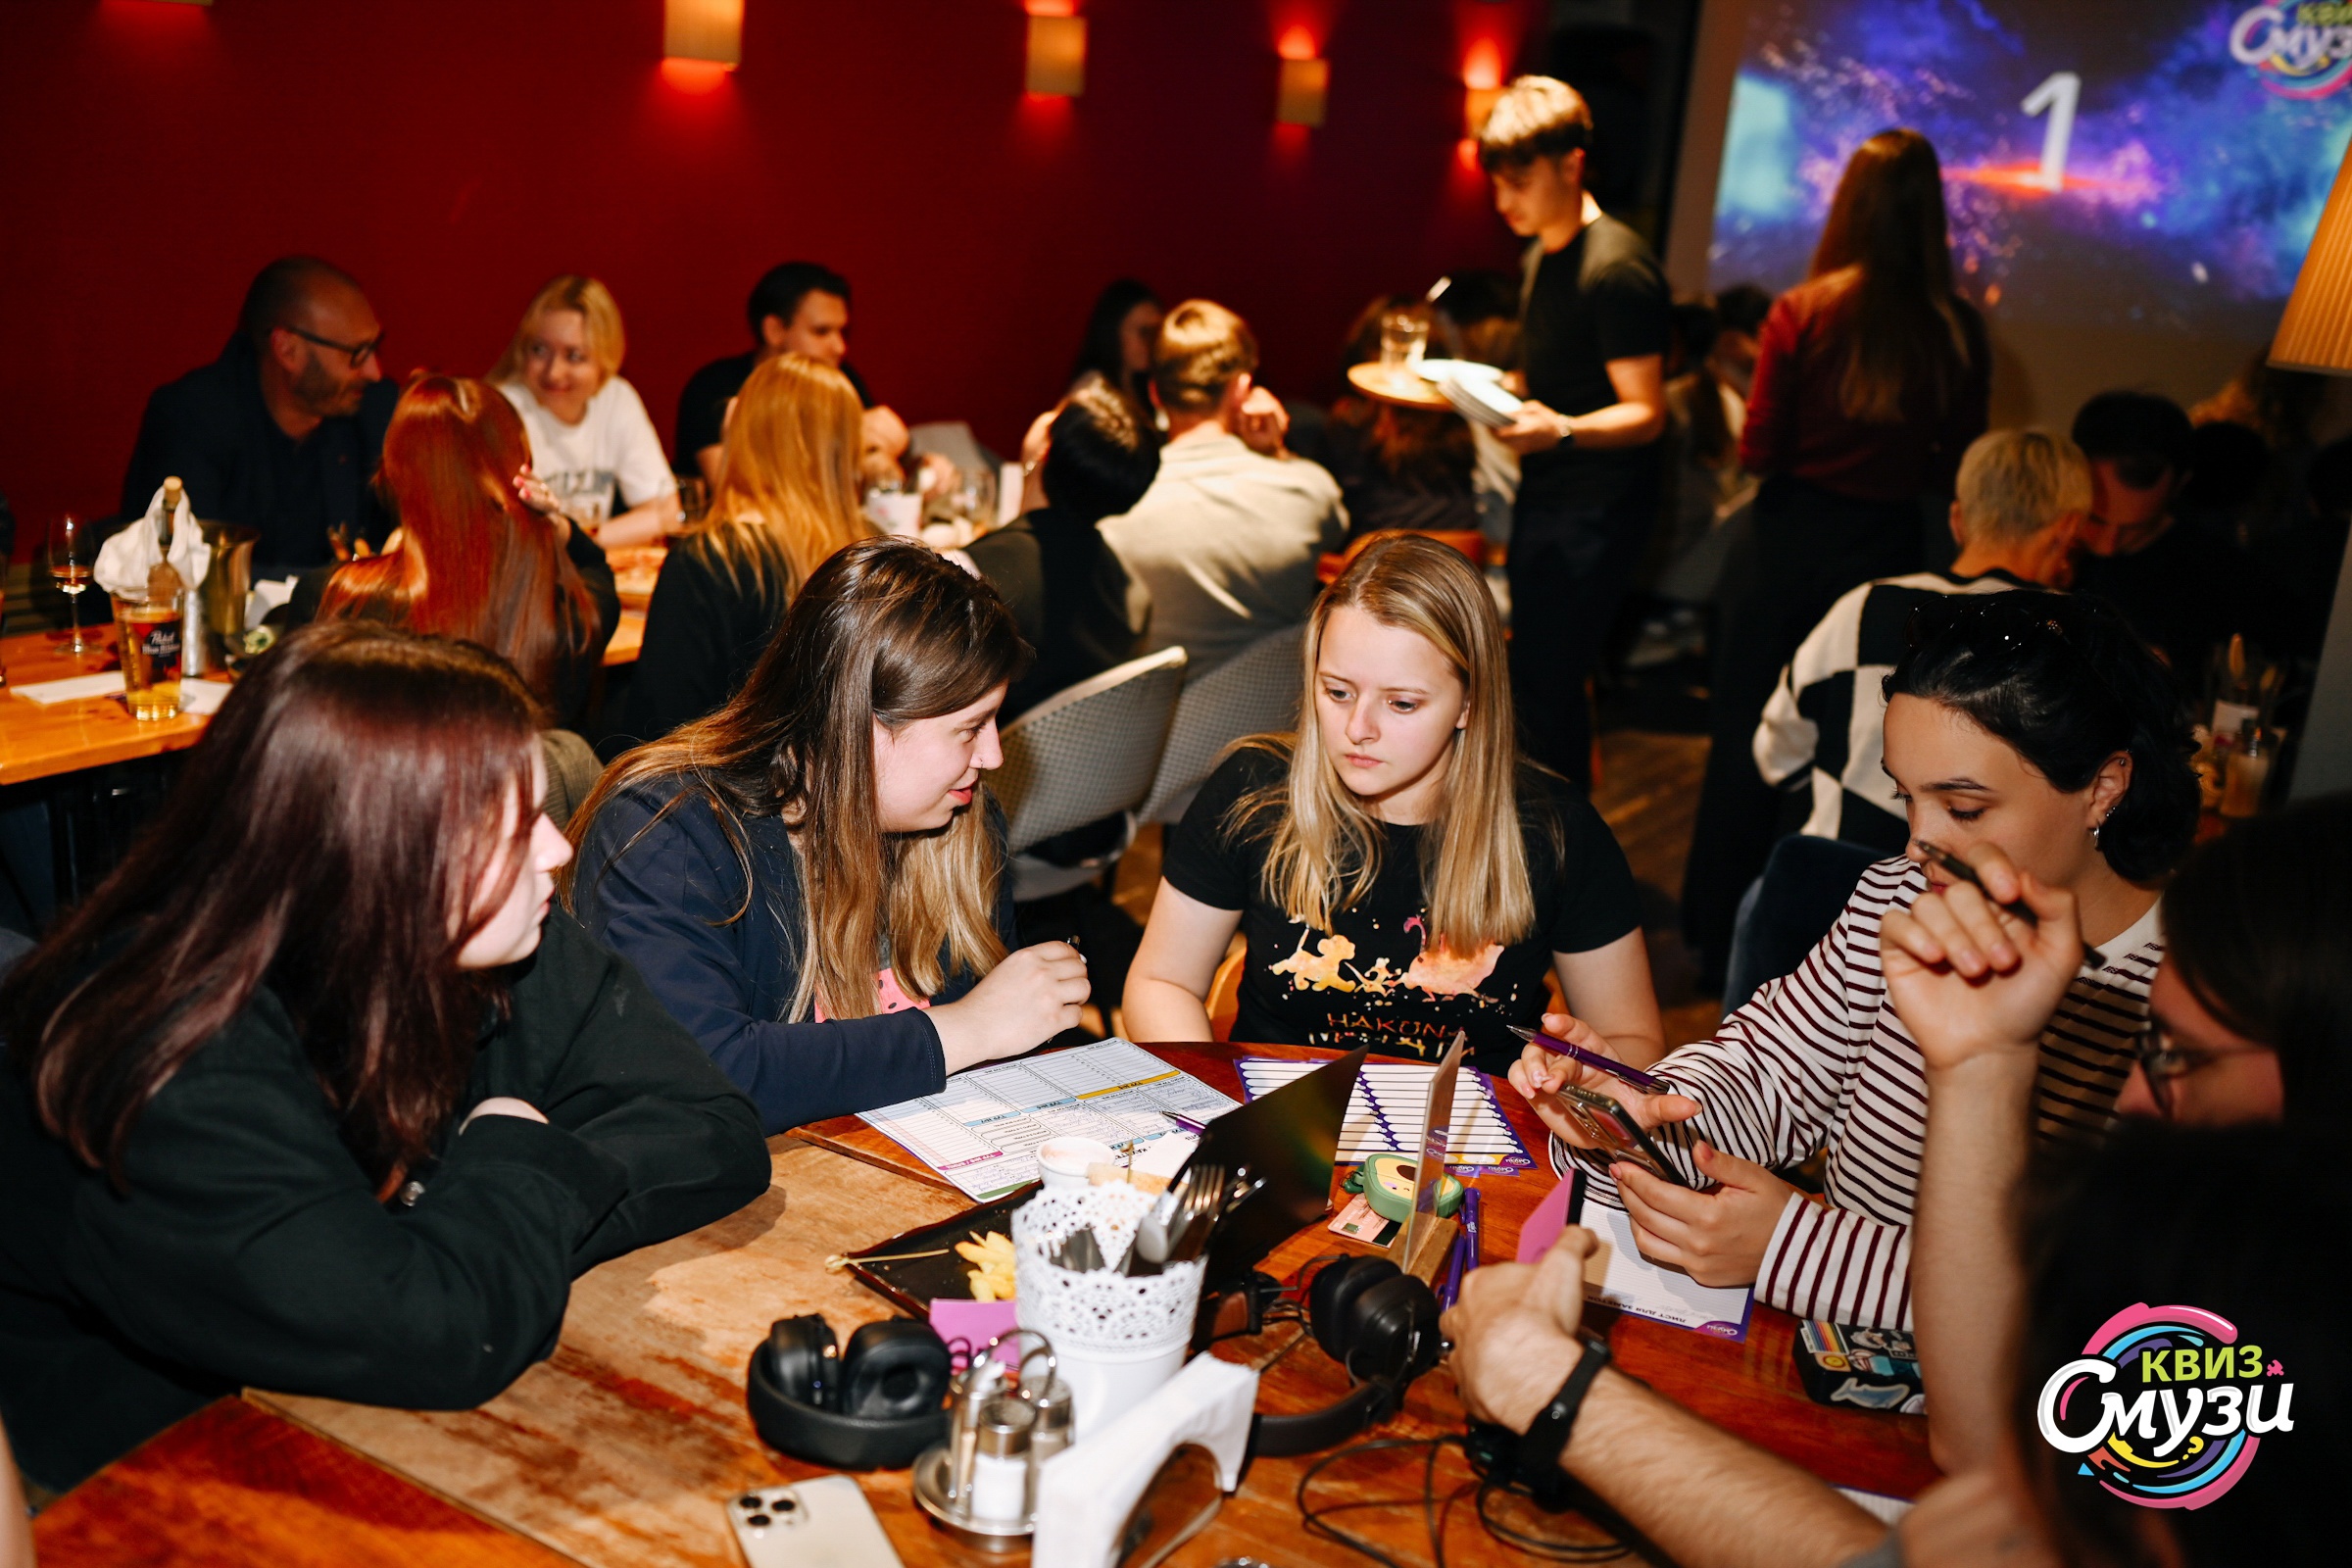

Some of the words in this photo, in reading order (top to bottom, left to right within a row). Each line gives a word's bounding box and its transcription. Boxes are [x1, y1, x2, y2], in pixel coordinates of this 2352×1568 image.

[2296, 2, 2352, 26] КВИ
[2230, 5, 2352, 70] Смуз
[2021, 72, 2082, 193] 1
[1504, 1155, 1531, 1166] Смузи
[1586, 1294, 1633, 1311] ЗАМЕТОК
[1633, 1305, 1656, 1316] ДЛЯ
[1657, 1313, 1687, 1324] ЛИСТ
[1705, 1324, 1739, 1337] Смузи
